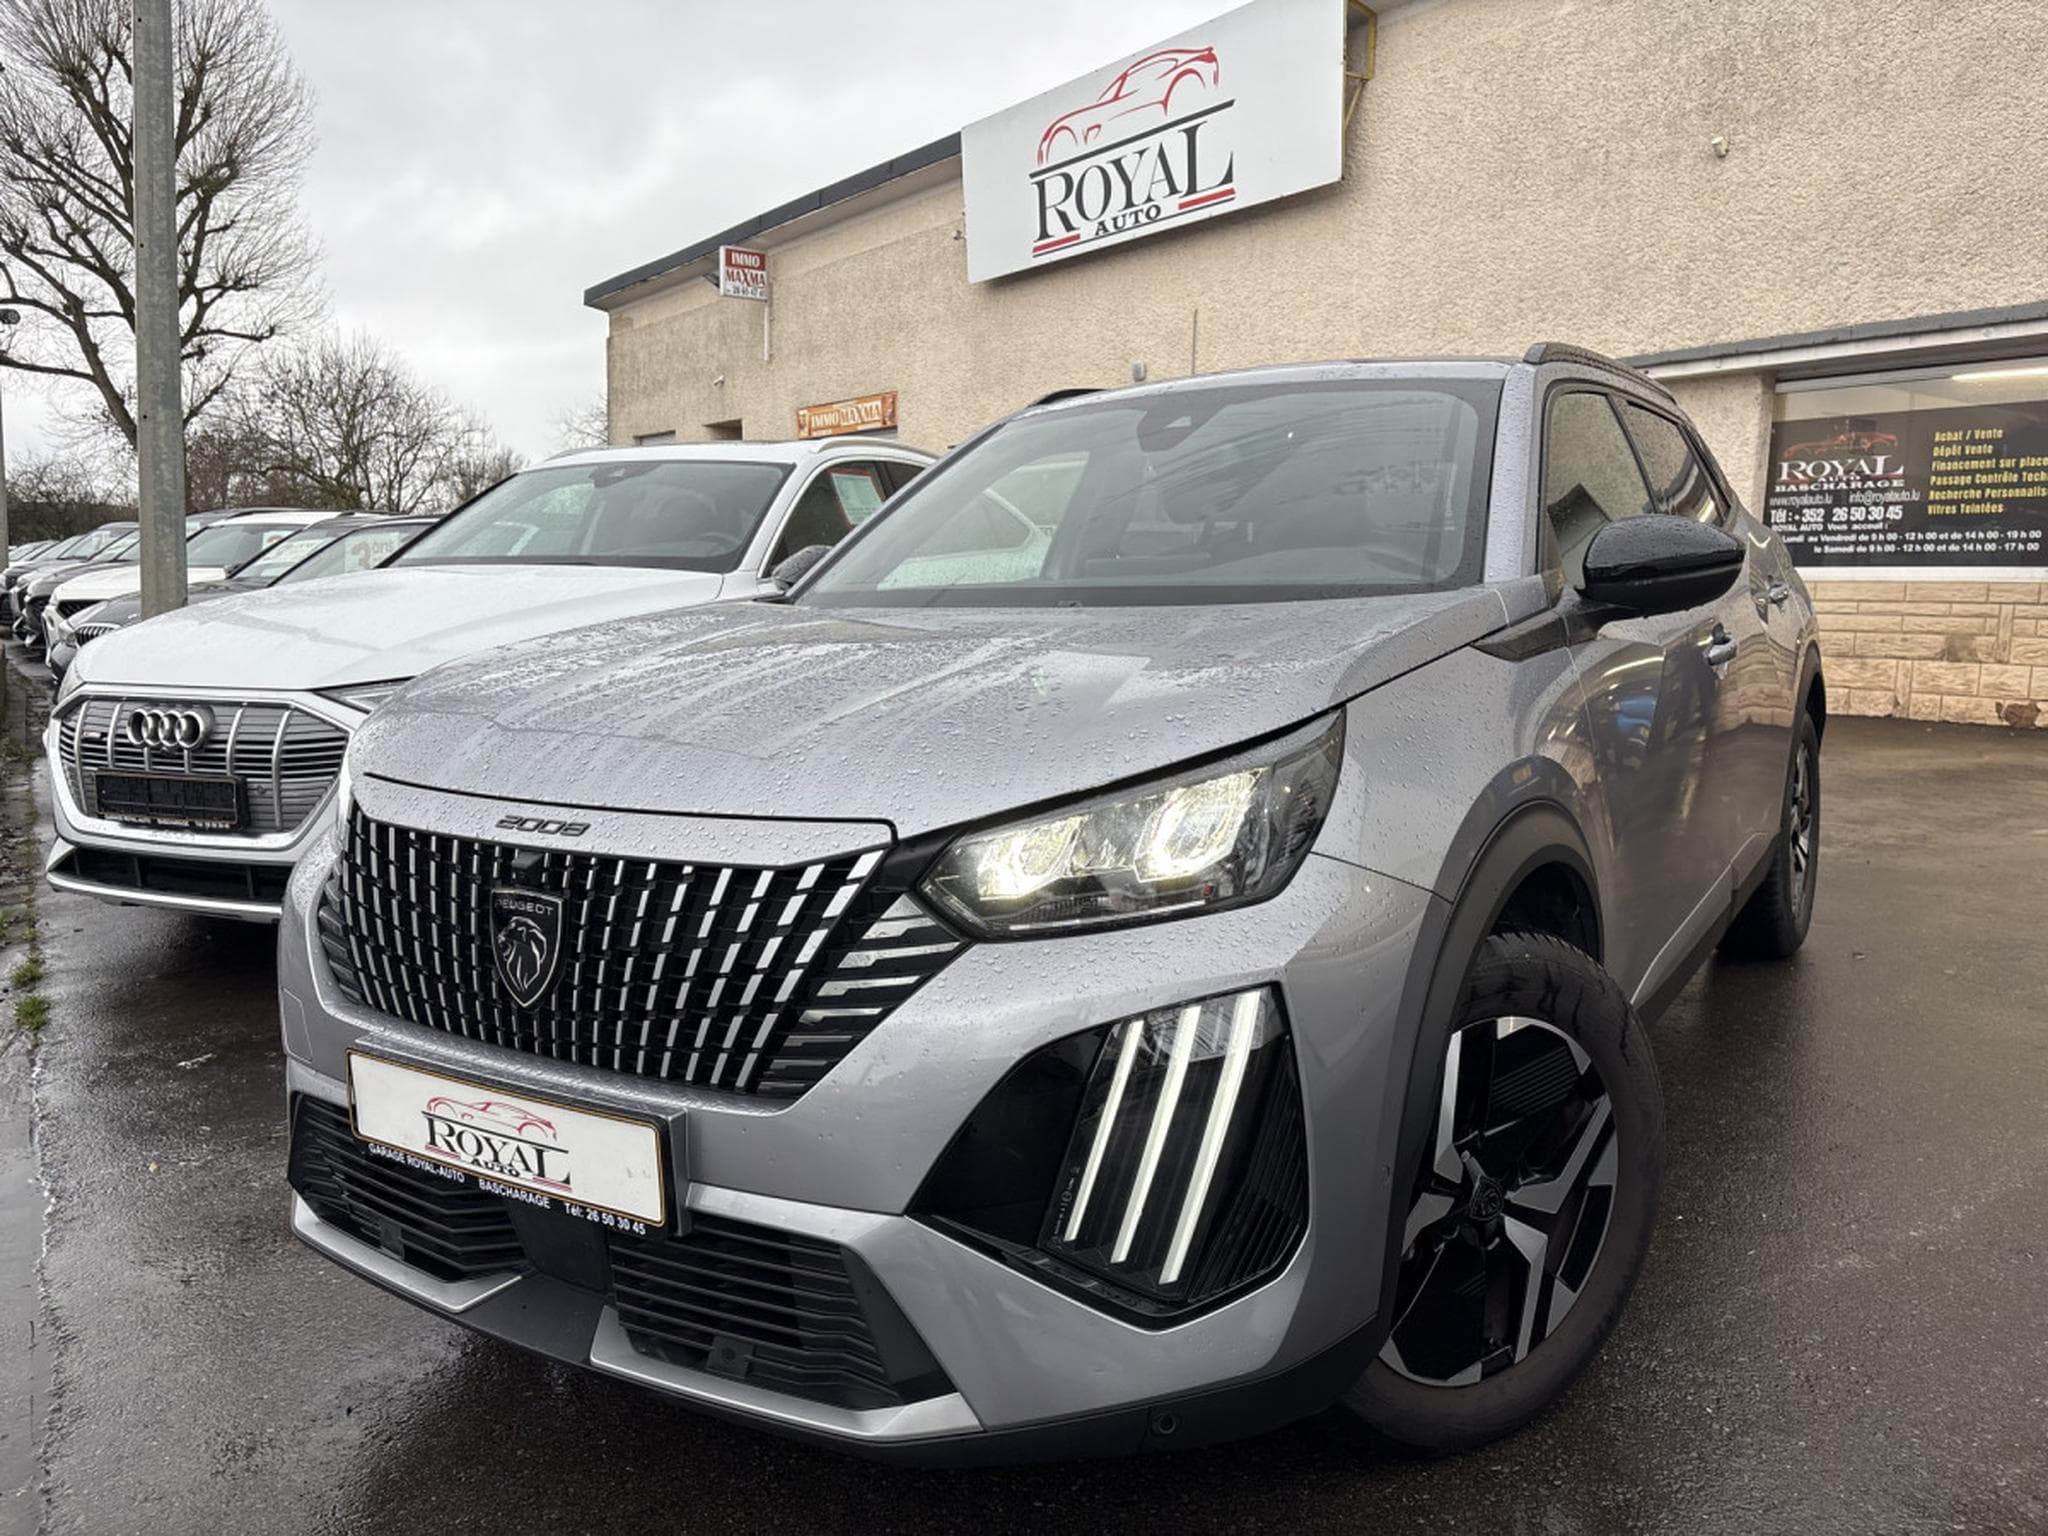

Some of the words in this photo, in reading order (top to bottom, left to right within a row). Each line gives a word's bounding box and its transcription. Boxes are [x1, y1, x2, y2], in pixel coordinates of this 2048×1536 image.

[1031, 121, 1235, 242] ROYAL
[1094, 204, 1162, 237] AUTO
[731, 251, 760, 268] IMMO
[726, 268, 766, 288] MAXMA
[811, 410, 839, 428] IMMO
[839, 402, 882, 425] MAXMA
[1934, 431, 1962, 442] Achat
[1974, 428, 2003, 440] Vente
[1964, 444, 1994, 456] Vente
[1779, 455, 1904, 481] ROYAL
[1931, 458, 1996, 471] Financement
[1999, 458, 2017, 468] sur
[1775, 479, 1905, 492] BASCHARAGE
[1818, 472, 1861, 482] AUTO
[1930, 474, 1972, 485] Passage
[1928, 490, 1982, 500] Recherche
[1801, 508, 1825, 523] 352
[1832, 507, 1849, 521] 26
[1850, 506, 1867, 521] 50
[1867, 506, 1885, 520] 30
[1886, 504, 1903, 519] 45
[1928, 504, 1957, 515] Vitres
[1799, 523, 1824, 531] AUTO
[1827, 522, 1848, 531] Vous
[1783, 534, 1805, 543] Lundi
[1820, 532, 1857, 541] Vendredi
[1858, 532, 1870, 541] de
[1871, 532, 1878, 541] 9
[1879, 532, 1886, 541] h
[1886, 531, 1898, 541] 00
[1905, 532, 1916, 541] 12
[1917, 532, 1924, 541] h
[1925, 531, 1938, 541] 00
[1939, 532, 1949, 540] et
[1950, 531, 1963, 540] de
[1965, 530, 1977, 540] 14
[1978, 530, 1985, 540] h
[1986, 530, 1999, 540] 00
[2006, 530, 2019, 539] 19
[2020, 530, 2027, 539] h
[2028, 530, 2042, 539] 00
[1823, 544, 1855, 554] Samedi
[1856, 545, 1868, 553] de
[1869, 544, 1875, 553] 9
[1876, 544, 1883, 552] h
[1884, 543, 1896, 553] 00
[1903, 543, 1914, 552] 12
[1915, 543, 1922, 552] h
[1923, 542, 1936, 552] 00
[1937, 543, 1947, 552] et
[1948, 543, 1961, 552] de
[1963, 542, 1974, 551] 14
[1975, 542, 1983, 551] h
[1984, 542, 1997, 551] 00
[2004, 542, 2016, 551] 17
[2017, 542, 2025, 551] h
[2026, 541, 2040, 551] 00
[496, 815, 591, 837] 2008
[497, 897, 554, 916] PEUGEOT
[424, 1115, 571, 1185] ROYAL
[470, 1157, 520, 1178] AUTO
[367, 1142, 405, 1164] GARAGE
[406, 1154, 466, 1183] ROYAL-AUTO
[478, 1177, 551, 1210] BASCHARAGE
[585, 1208, 600, 1223] 26
[601, 1213, 616, 1227] 50
[617, 1217, 632, 1231] 30
[632, 1221, 647, 1236] 45
